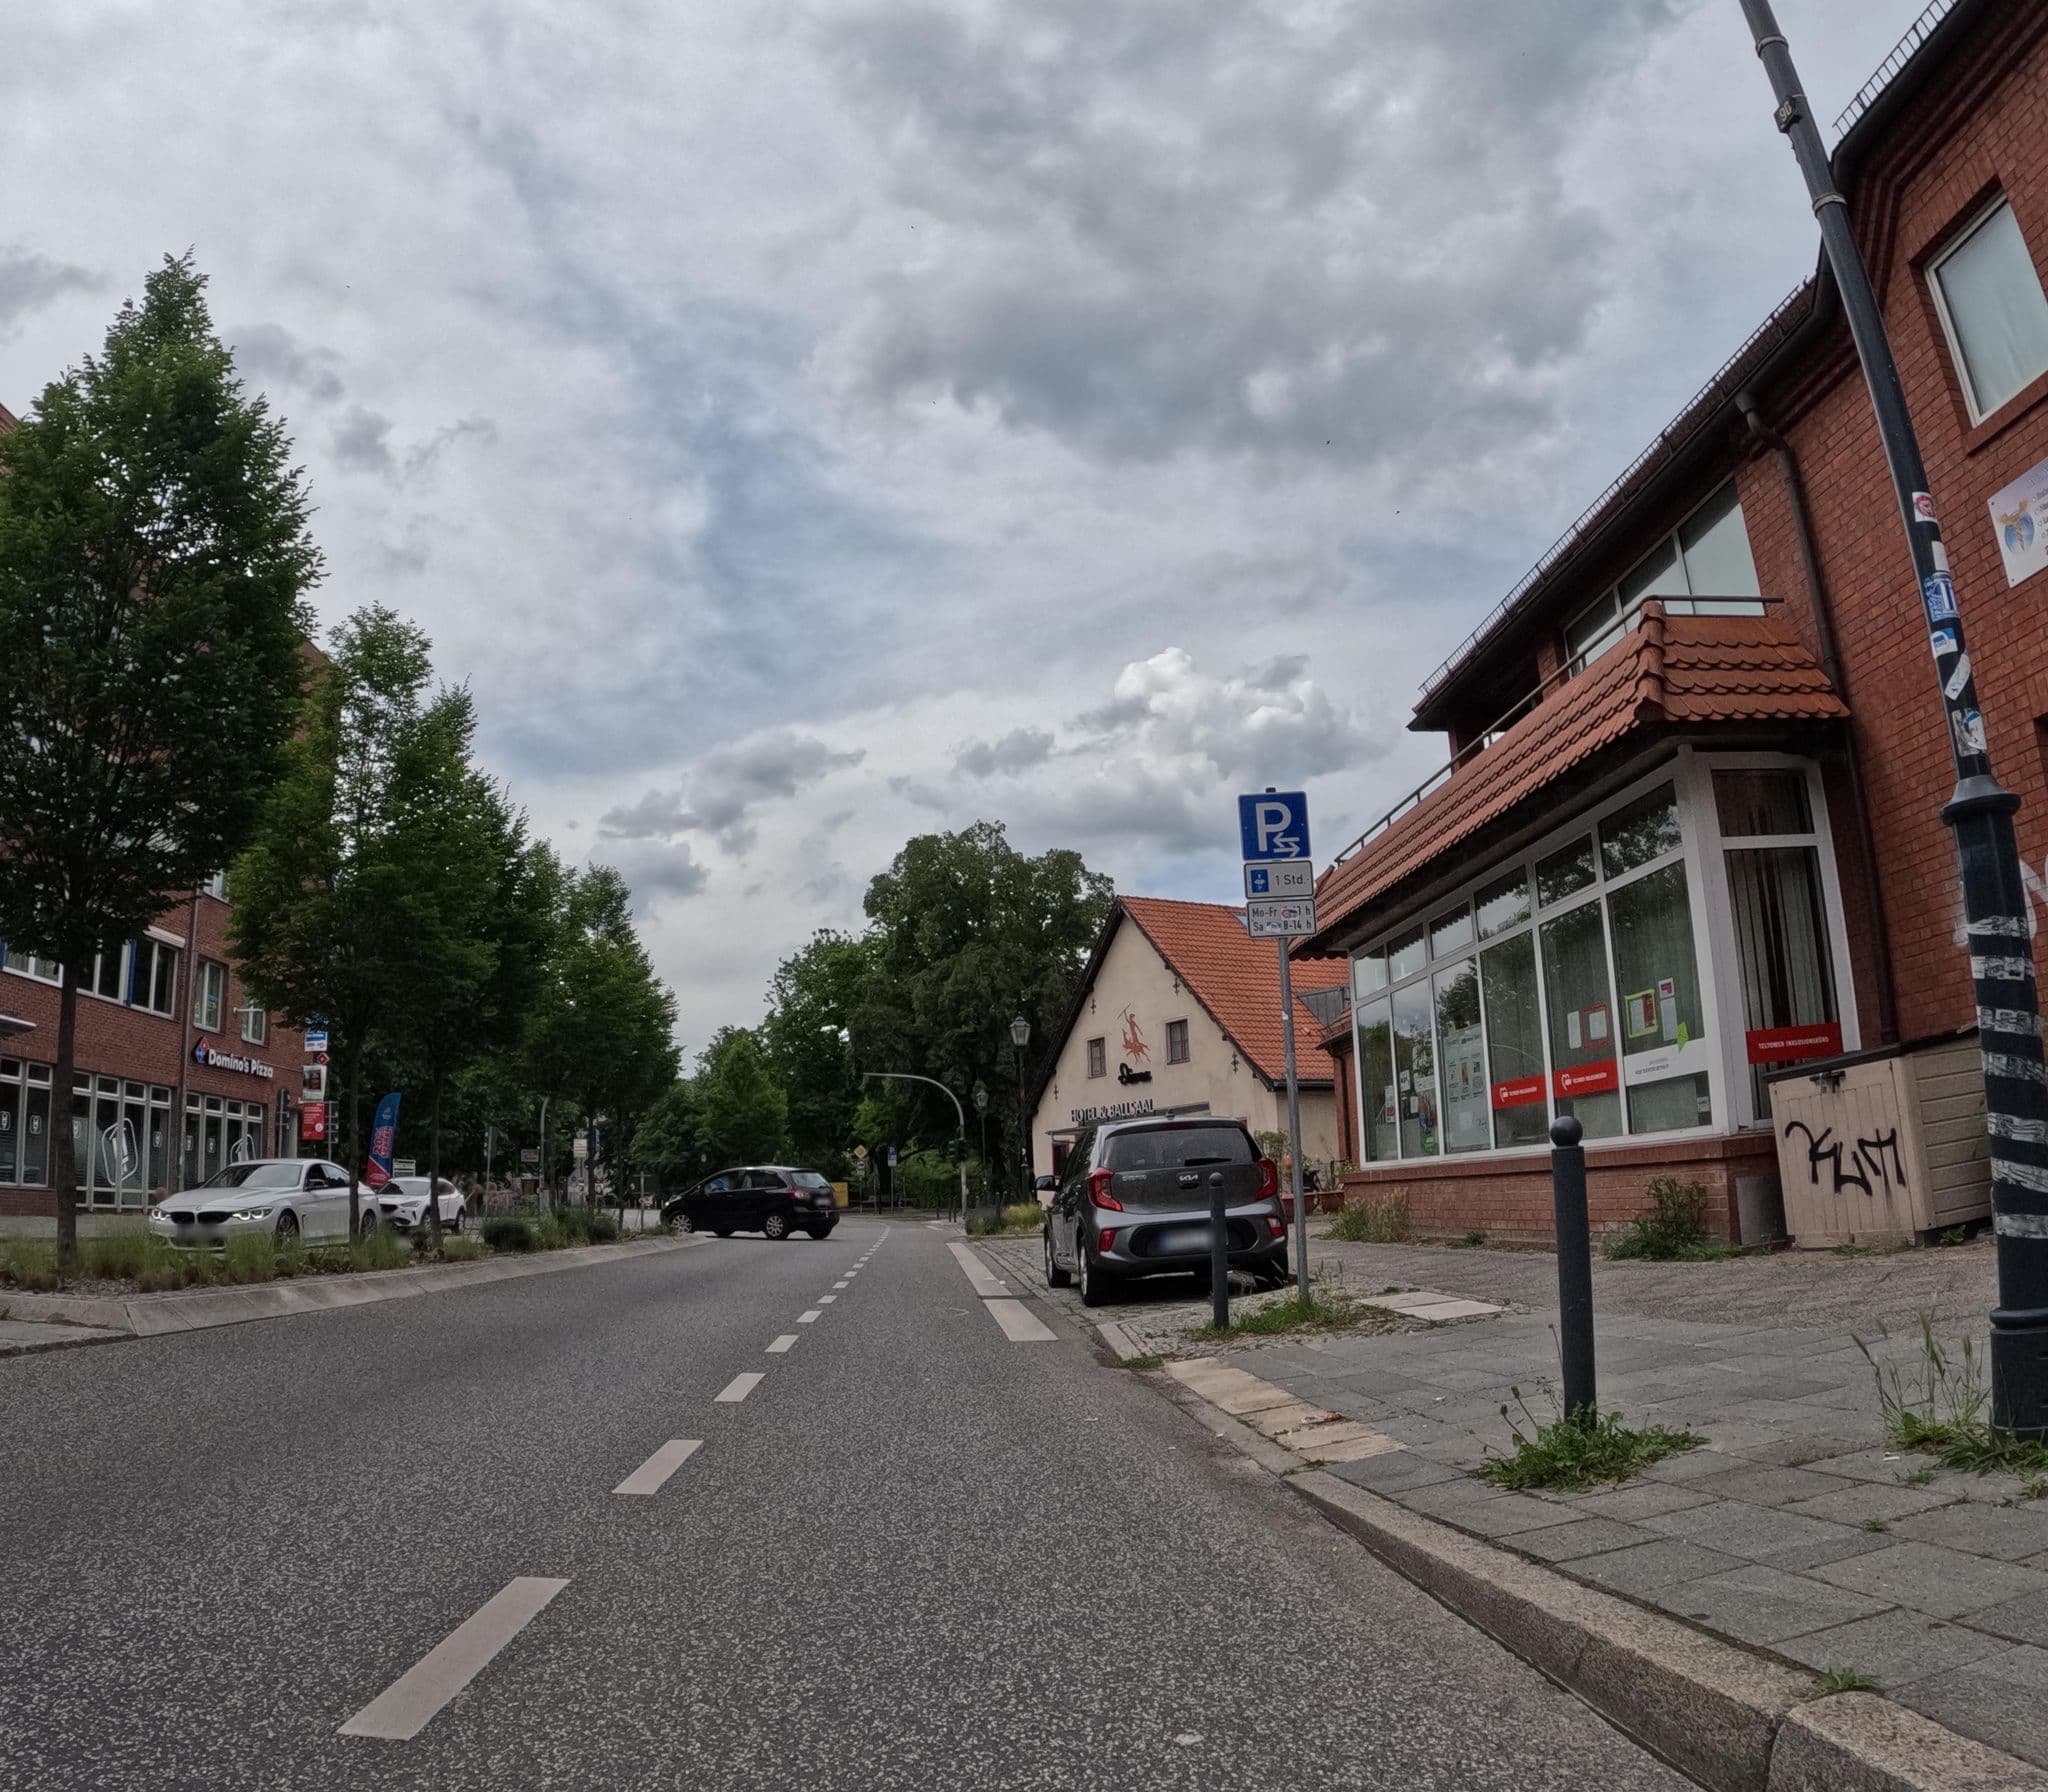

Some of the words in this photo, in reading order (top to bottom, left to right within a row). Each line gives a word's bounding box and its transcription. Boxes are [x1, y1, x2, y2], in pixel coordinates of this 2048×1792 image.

[1256, 802, 1292, 852] P
[1275, 876, 1280, 886] 1
[1252, 906, 1278, 918] Mo-Fr
[1305, 905, 1311, 915] h
[1253, 922, 1264, 931] Sa
[1306, 920, 1312, 929] h
[208, 1048, 250, 1073] Domino's
[250, 1059, 274, 1078] Pizza
[1071, 1106, 1097, 1121] HOTEL
[1109, 1099, 1154, 1118] BALLSAAL
